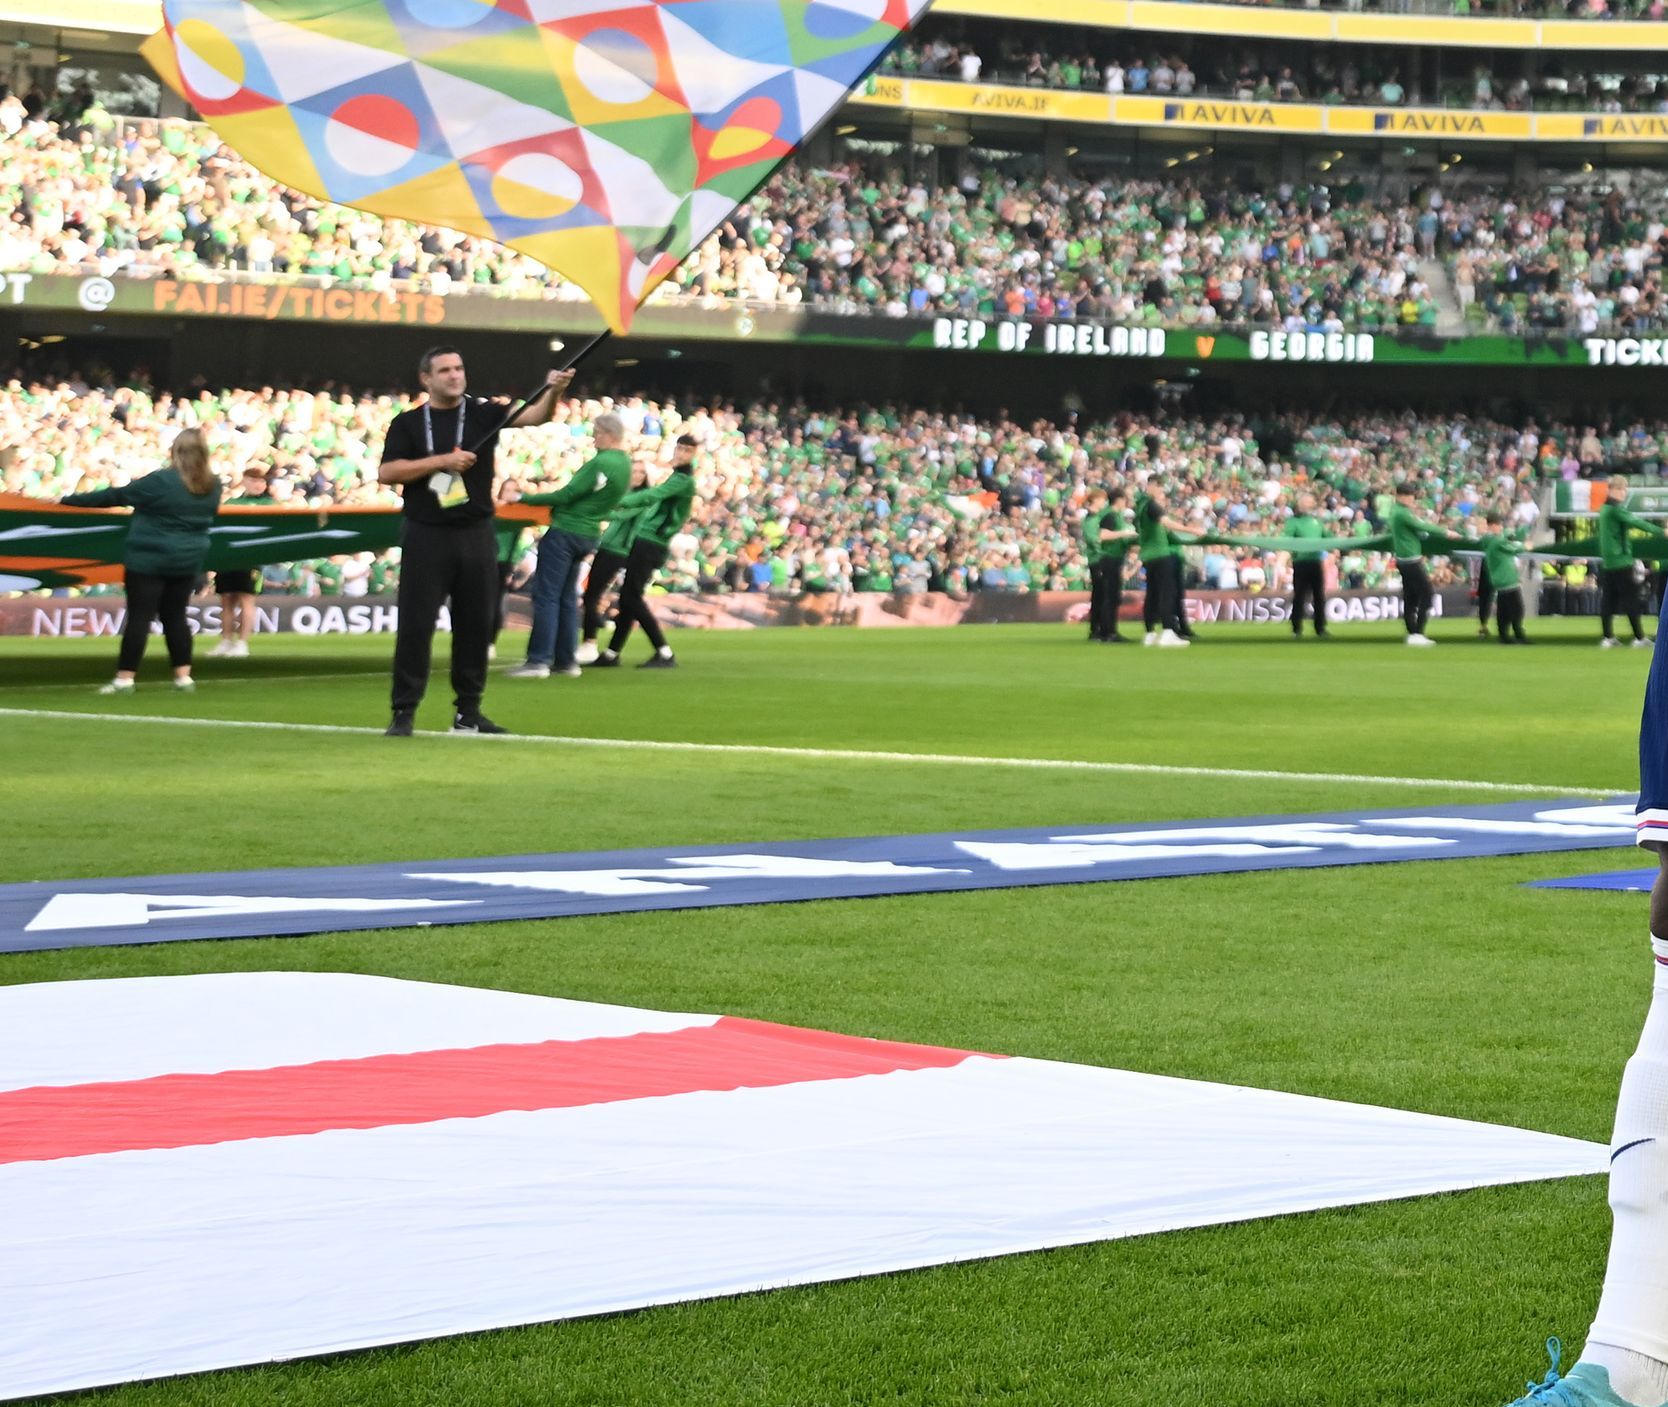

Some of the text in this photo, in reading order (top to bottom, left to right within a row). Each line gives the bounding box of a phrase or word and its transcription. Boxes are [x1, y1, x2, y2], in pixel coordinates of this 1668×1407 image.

[1193, 105, 1276, 126] AVIVA
[1402, 113, 1487, 133] AVIVA
[154, 281, 446, 324] FAI.IE/TICKETS
[934, 318, 986, 349] REP
[997, 321, 1032, 352] OF
[1045, 323, 1167, 357] IRELAND
[1249, 330, 1375, 362] GEORGIA
[33, 607, 126, 637] NEW
